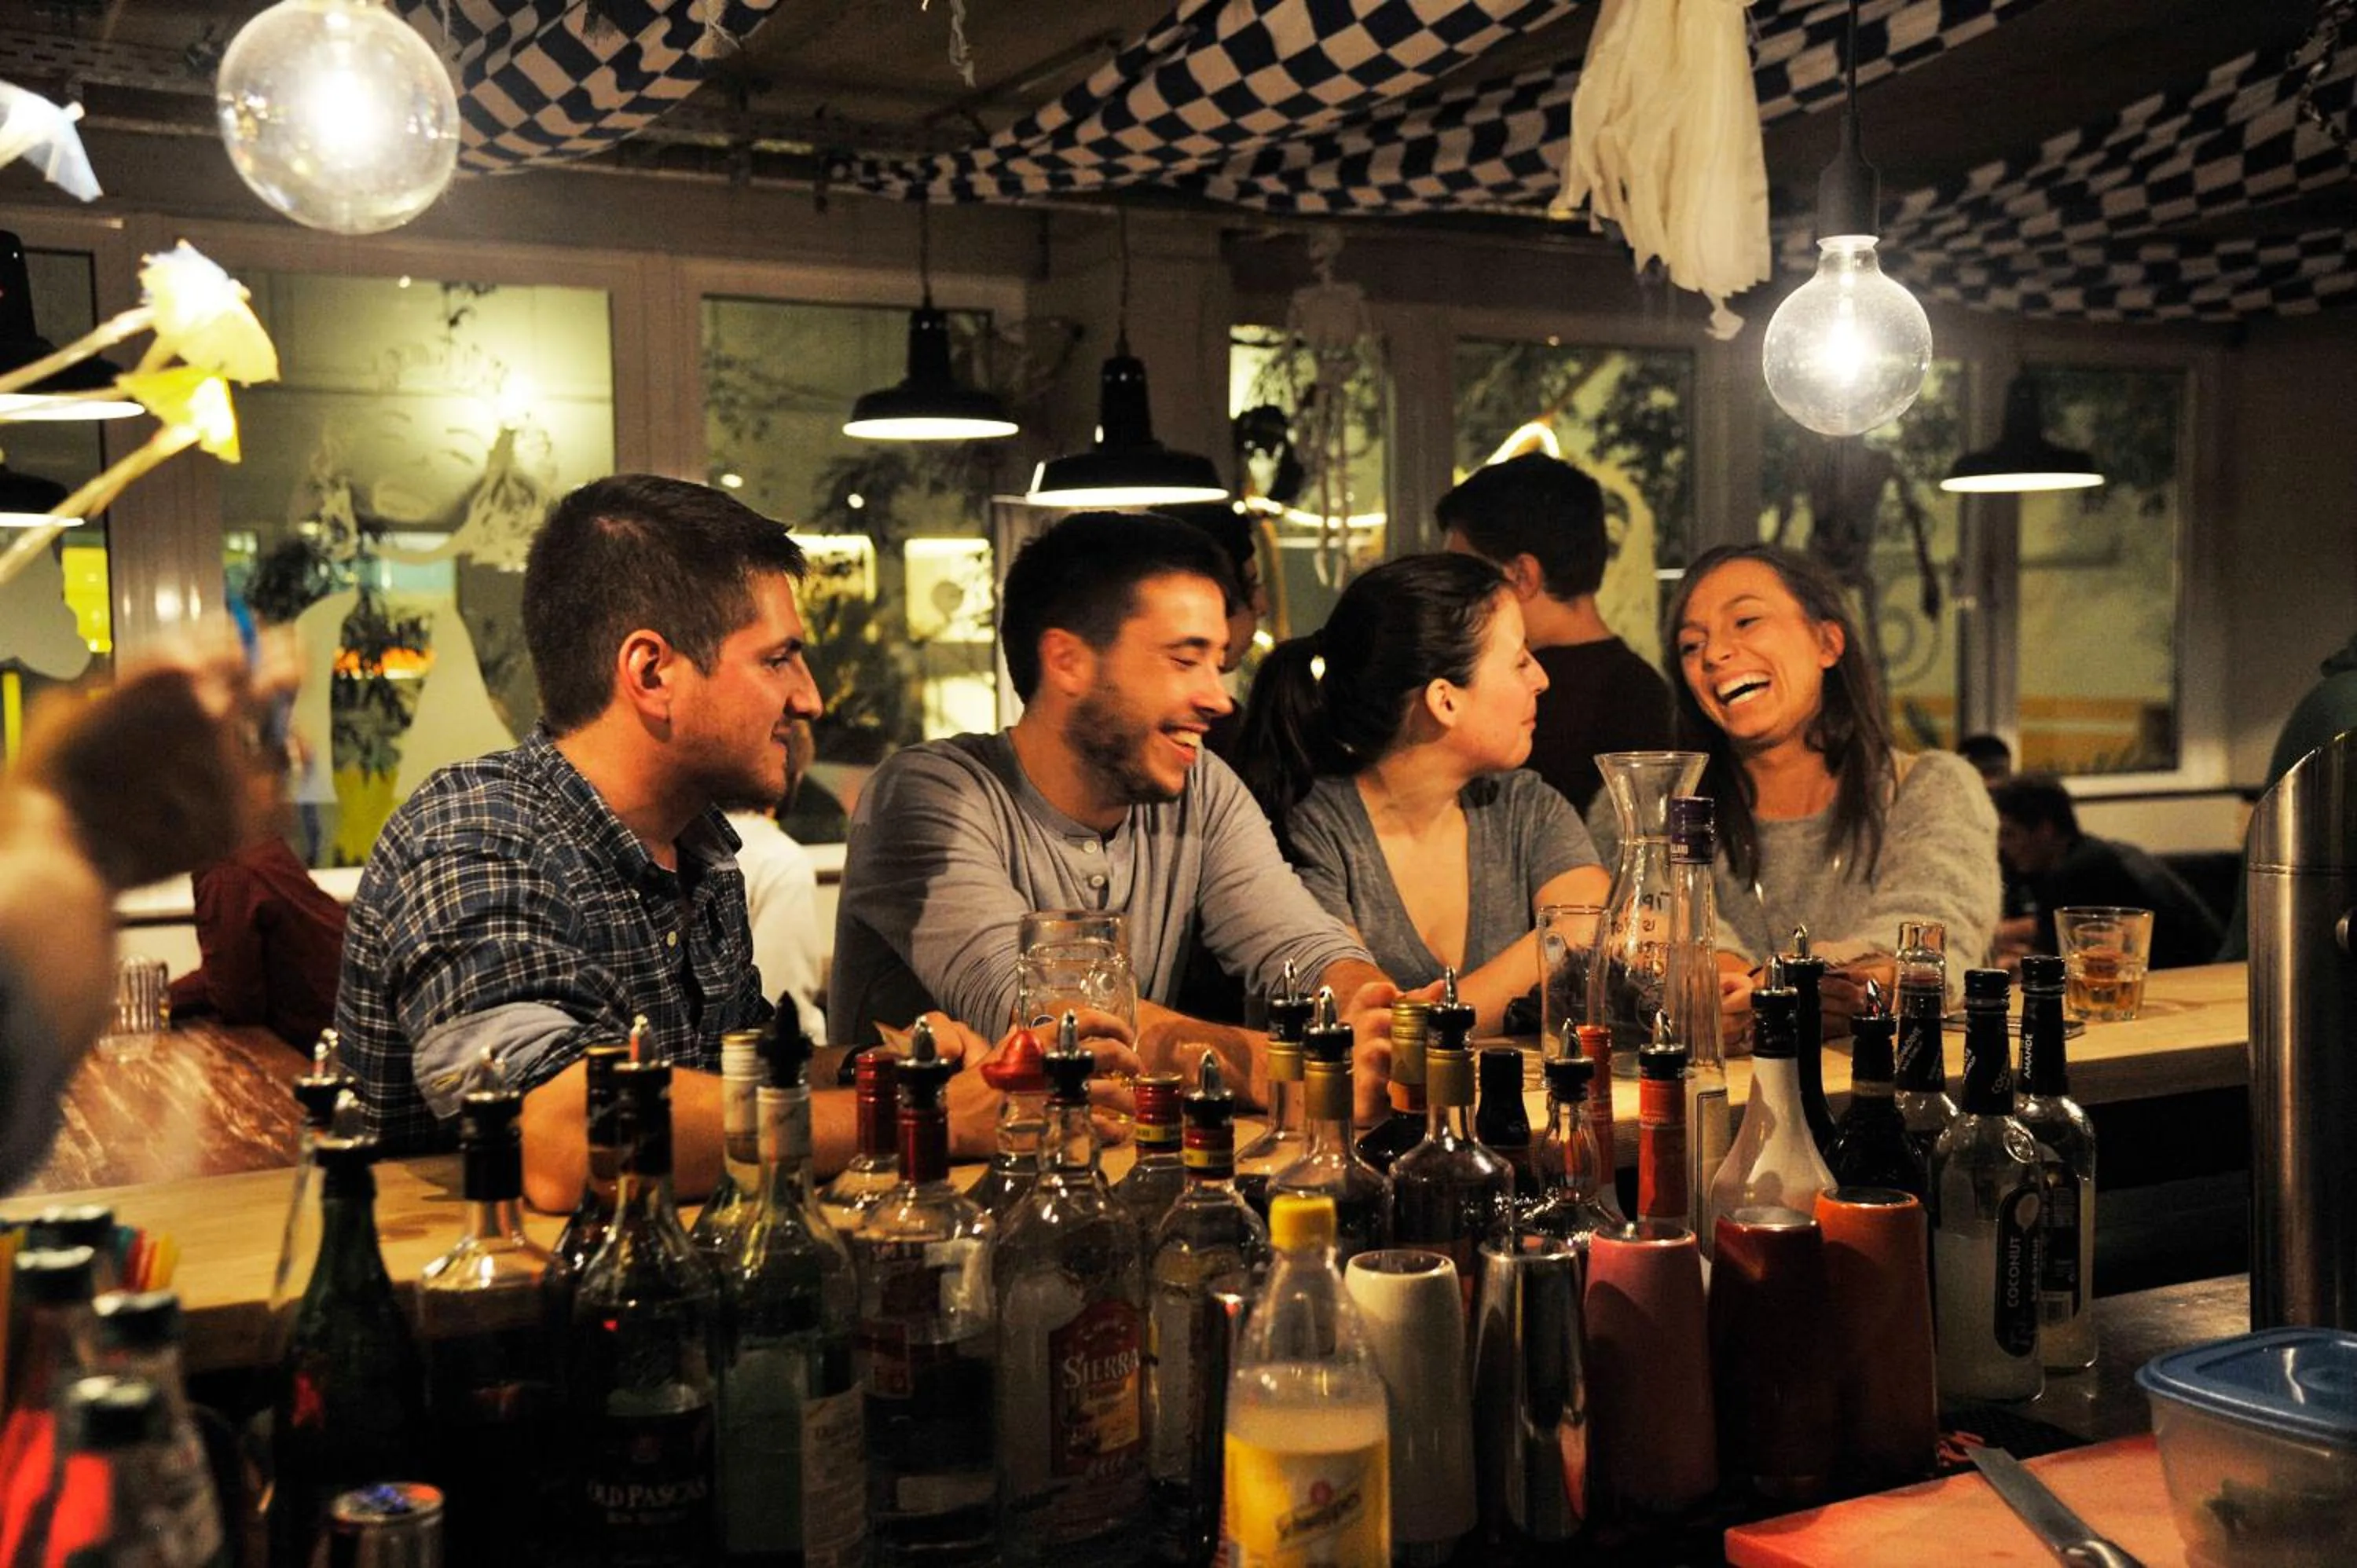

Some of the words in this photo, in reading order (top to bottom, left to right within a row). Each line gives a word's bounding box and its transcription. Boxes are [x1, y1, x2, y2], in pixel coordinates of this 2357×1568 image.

[2023, 1032, 2034, 1080] AMANDE
[2007, 1236, 2022, 1308] COCONUT
[1062, 1348, 1140, 1390] SIERRA
